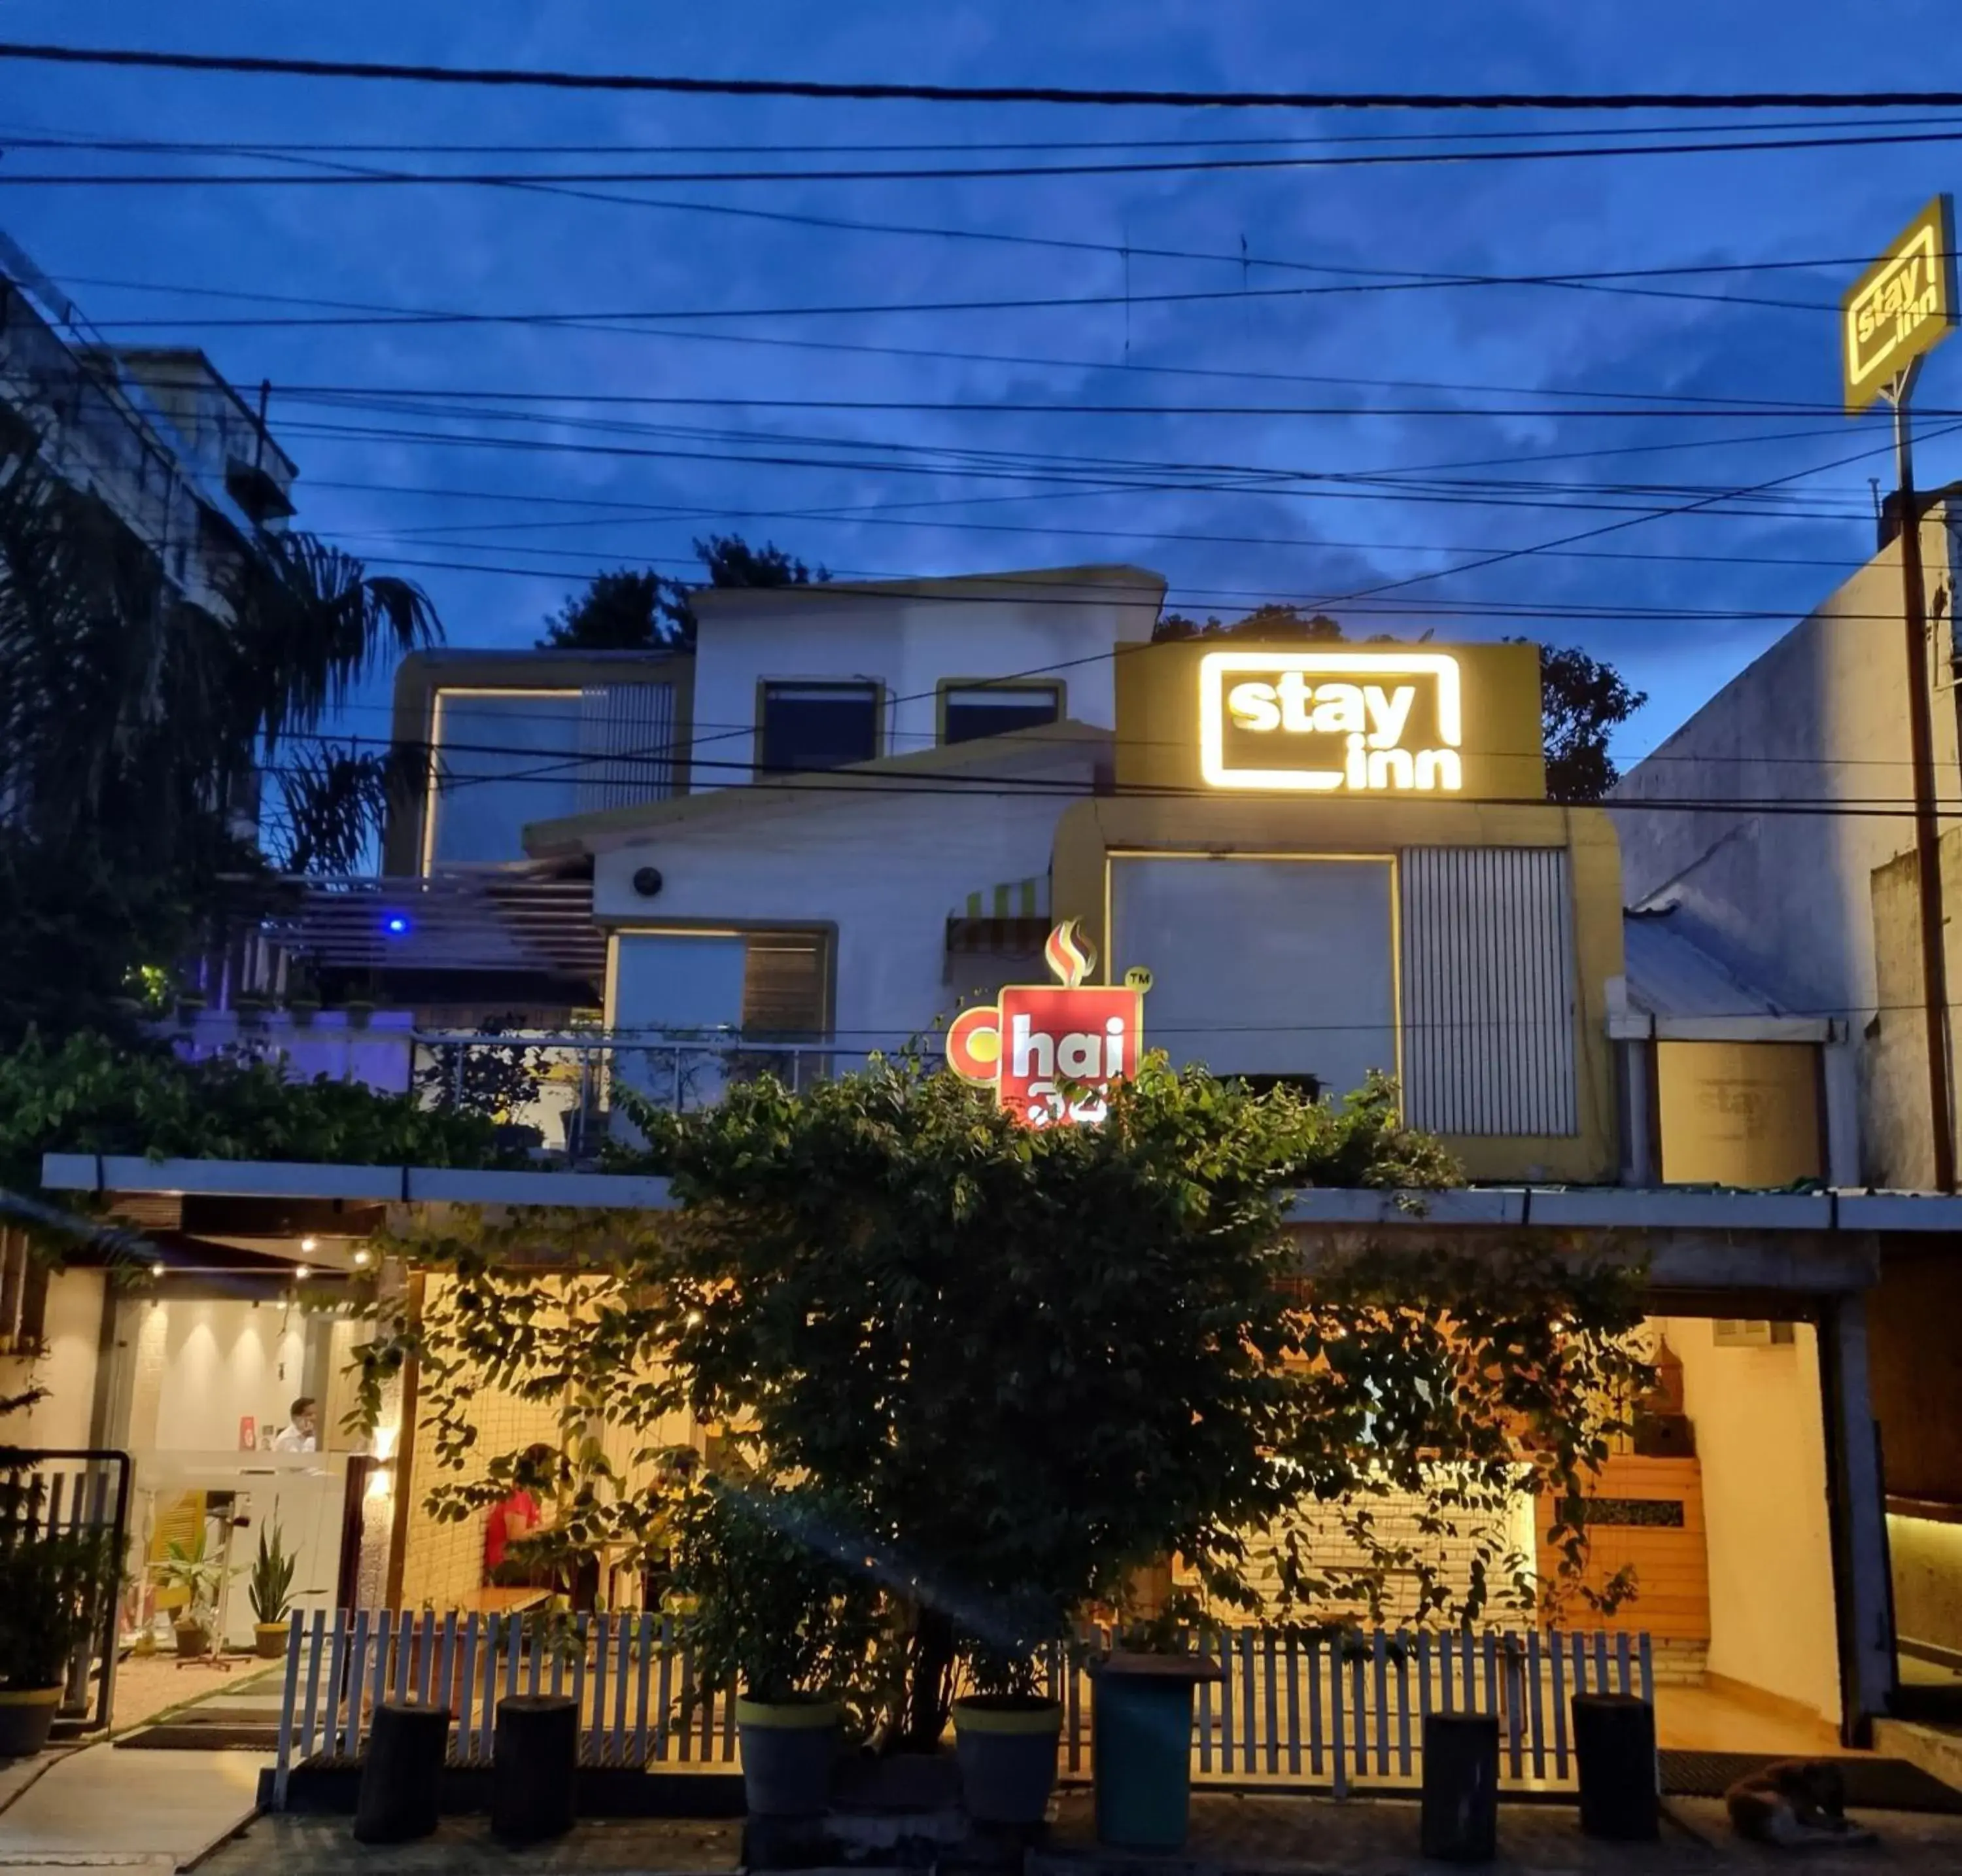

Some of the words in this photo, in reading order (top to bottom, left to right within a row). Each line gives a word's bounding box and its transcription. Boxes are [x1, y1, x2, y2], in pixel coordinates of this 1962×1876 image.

[1859, 256, 1919, 343] stay
[1895, 285, 1937, 343] inn
[1229, 671, 1415, 750] stay
[1347, 732, 1462, 790] inn
[1129, 972, 1150, 983] TM
